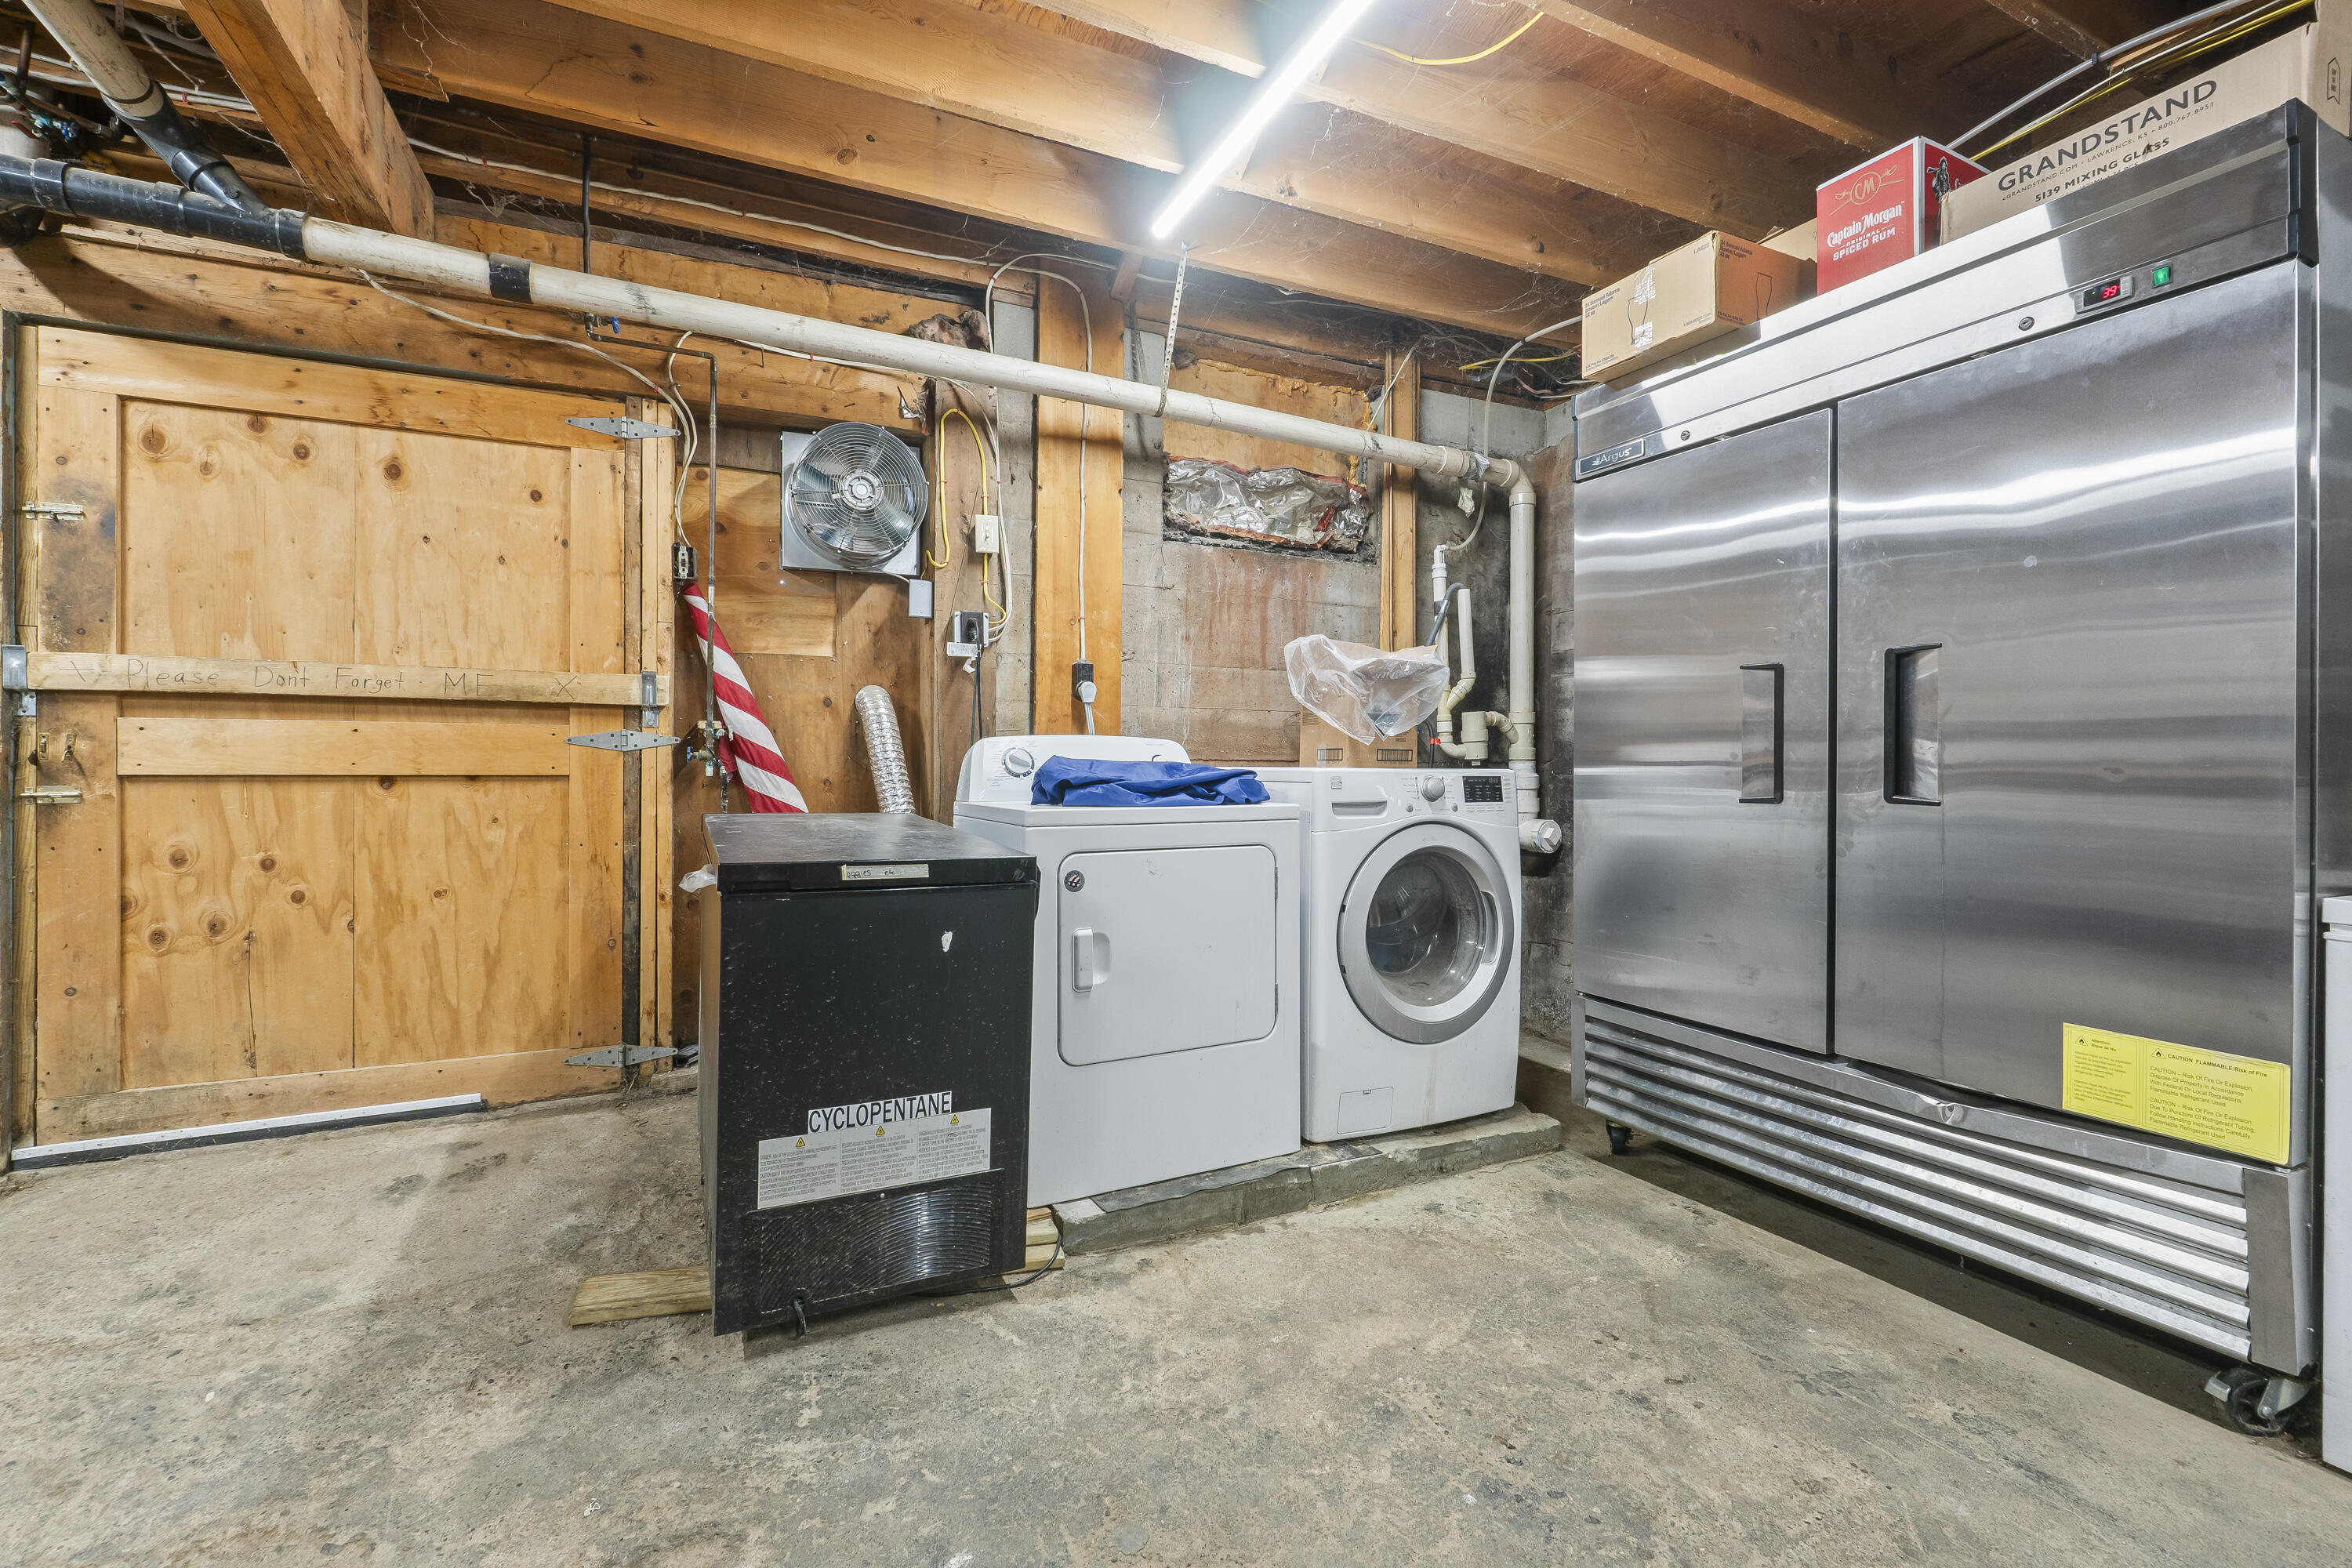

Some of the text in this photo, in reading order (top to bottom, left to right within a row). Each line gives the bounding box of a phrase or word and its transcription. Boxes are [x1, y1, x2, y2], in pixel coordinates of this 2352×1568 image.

[2138, 132, 2148, 140] KS
[2158, 102, 2214, 132] 800.767.8951
[1998, 80, 2217, 191] GRANDSTAND
[2034, 185, 2060, 202] 5139
[2064, 160, 2118, 190] MIXING
[2122, 137, 2170, 163] GLASS
[1854, 176, 1875, 201] CM
[1827, 220, 1862, 248] Captain
[1832, 227, 1896, 261] SPICED RUM
[1846, 229, 1881, 247] ORIGINAL
[1726, 241, 1740, 250] Samuel
[1740, 246, 1753, 255] Adams
[1606, 288, 1621, 298] Adams
[2102, 285, 2118, 299] 39
[127, 659, 220, 689] Please
[336, 667, 405, 695] Forget
[444, 672, 495, 697] ME
[554, 675, 579, 701] X
[2151, 1065, 2176, 1076] CAUTION
[2168, 1054, 2193, 1063] CAUTION
[2195, 1059, 2248, 1073] FLAMMABLE-Risk
[2151, 1072, 2172, 1082] Dispose
[2180, 1079, 2203, 1089] Property
[2211, 1085, 2245, 1097] Accordance
[2151, 1086, 2227, 1107] Flammable Refrigerant Used
[2163, 1081, 2183, 1091] Federal
[808, 1091, 952, 1134] CYCLOPENTANE
[2150, 1097, 2176, 1107] CAUTION
[2224, 1113, 2252, 1124] Explosion
[2150, 1110, 2167, 1119] Follow
[2168, 1115, 2191, 1125] Handling
[2192, 1120, 2224, 1132] Instructions
[2169, 1108, 2194, 1118] Puncture
[2203, 1115, 2234, 1127] Refrigerant
[2150, 1116, 2226, 1140] Flammable Refrigerant Used
